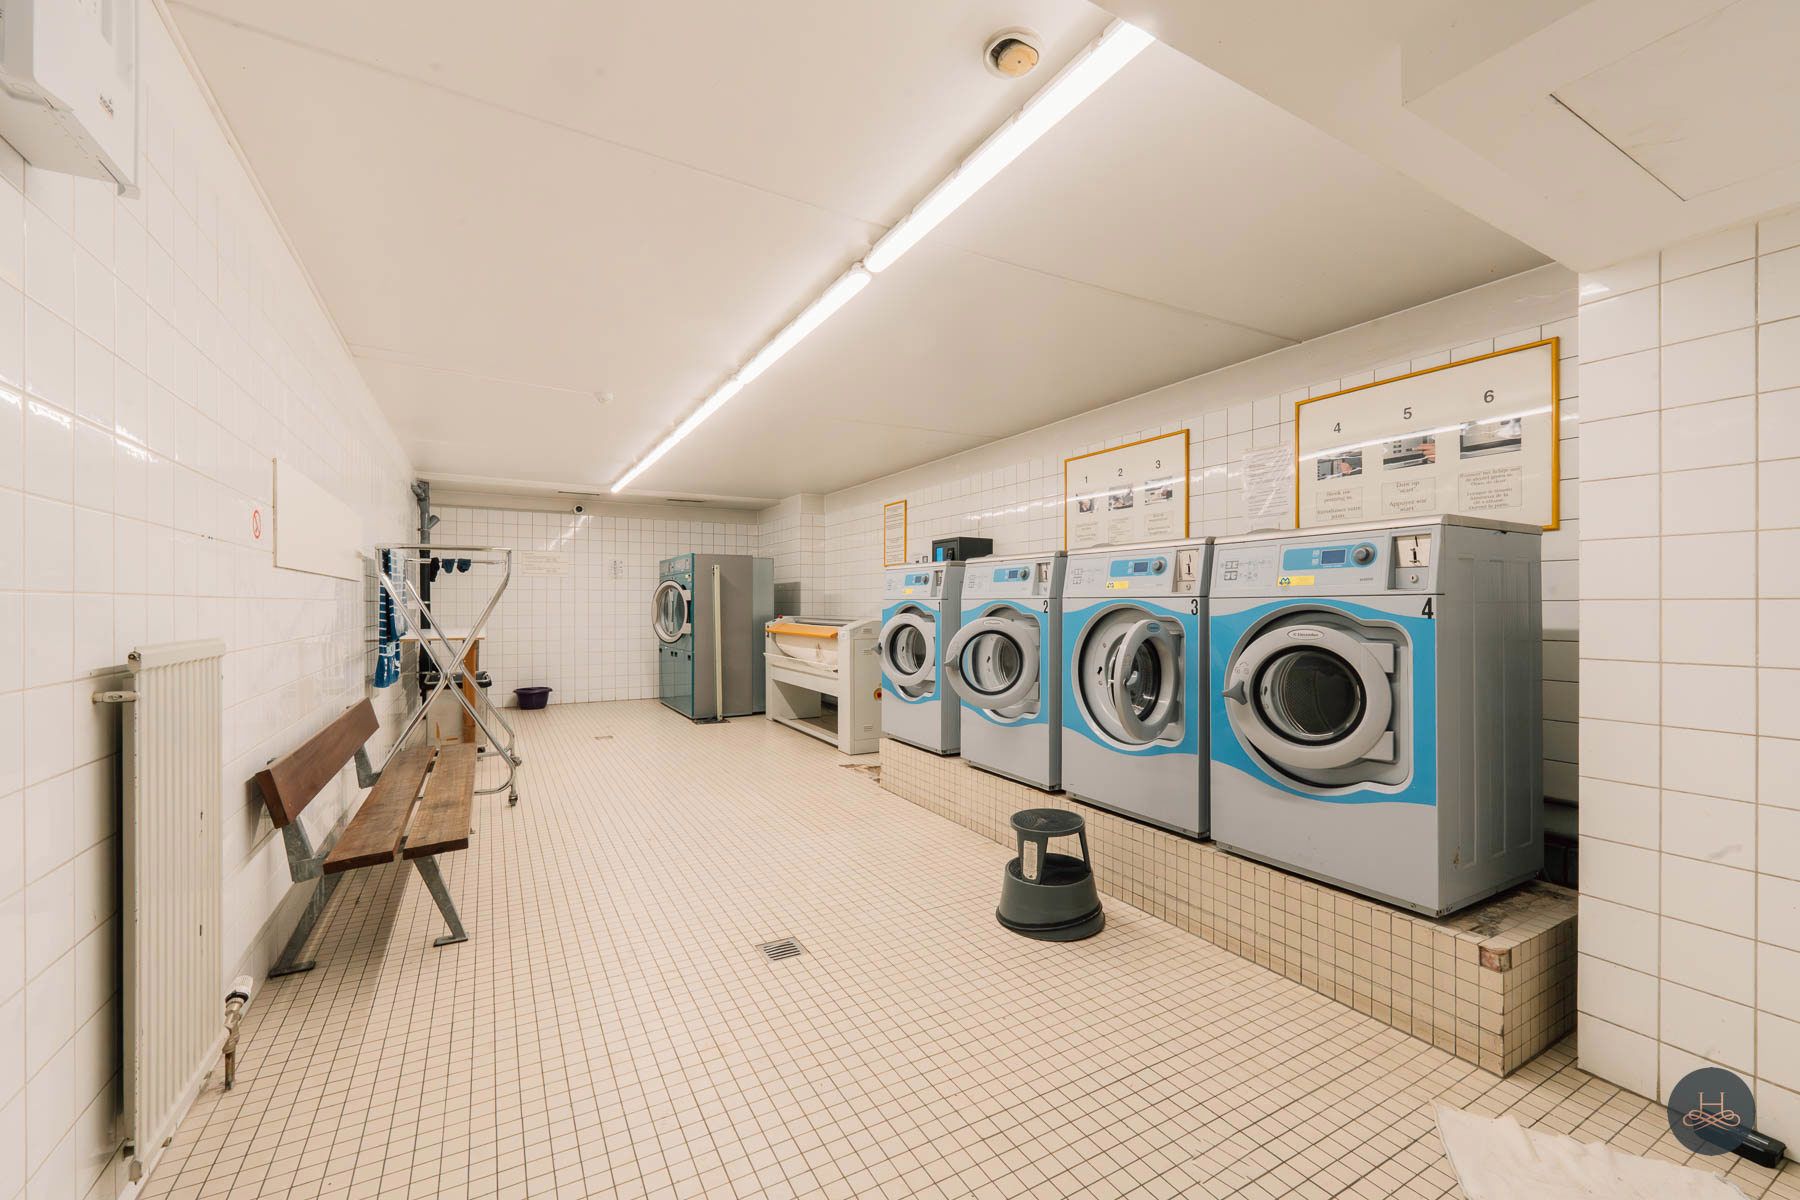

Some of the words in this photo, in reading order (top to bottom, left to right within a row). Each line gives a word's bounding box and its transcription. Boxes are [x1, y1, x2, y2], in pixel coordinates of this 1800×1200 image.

[1483, 389, 1495, 403] 6
[1403, 407, 1412, 420] 5
[1333, 422, 1342, 434] 4
[1155, 460, 1161, 469] 3
[1118, 468, 1123, 477] 2
[1043, 600, 1049, 613] 2
[1191, 599, 1199, 615] 3
[1421, 597, 1434, 619] 4
